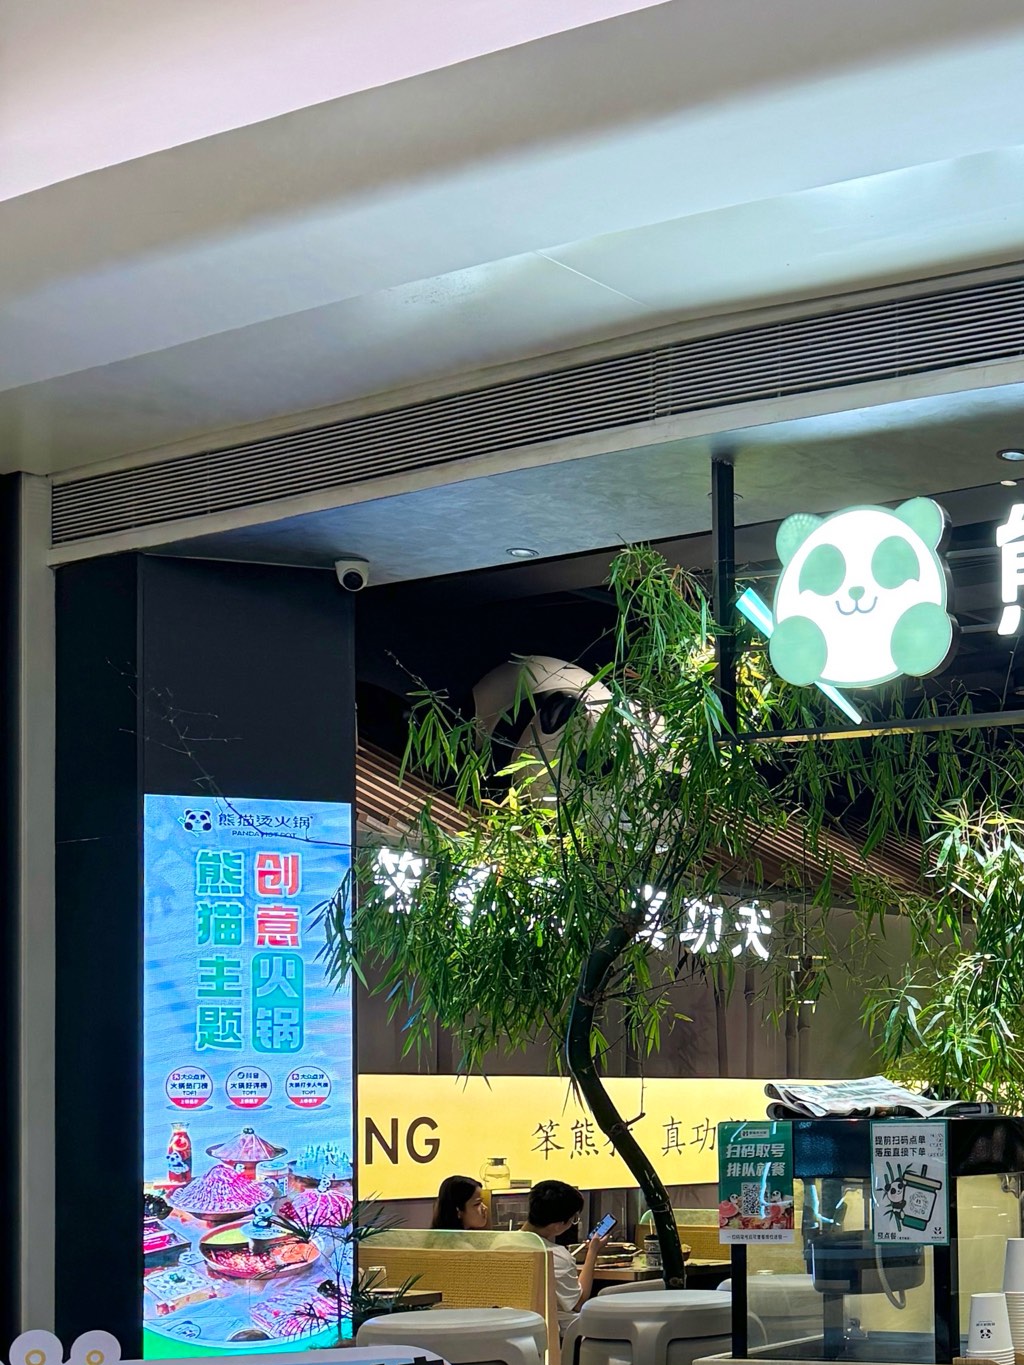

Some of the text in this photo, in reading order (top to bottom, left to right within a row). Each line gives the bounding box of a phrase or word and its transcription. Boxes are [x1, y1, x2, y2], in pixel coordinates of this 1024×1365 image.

[218, 813, 313, 829] 熊猫烫火锅
[194, 849, 245, 1053] 熊猫主题
[255, 851, 302, 1053] 创意火锅
[364, 1115, 441, 1166] NG
[726, 1143, 786, 1159] 扫码取号
